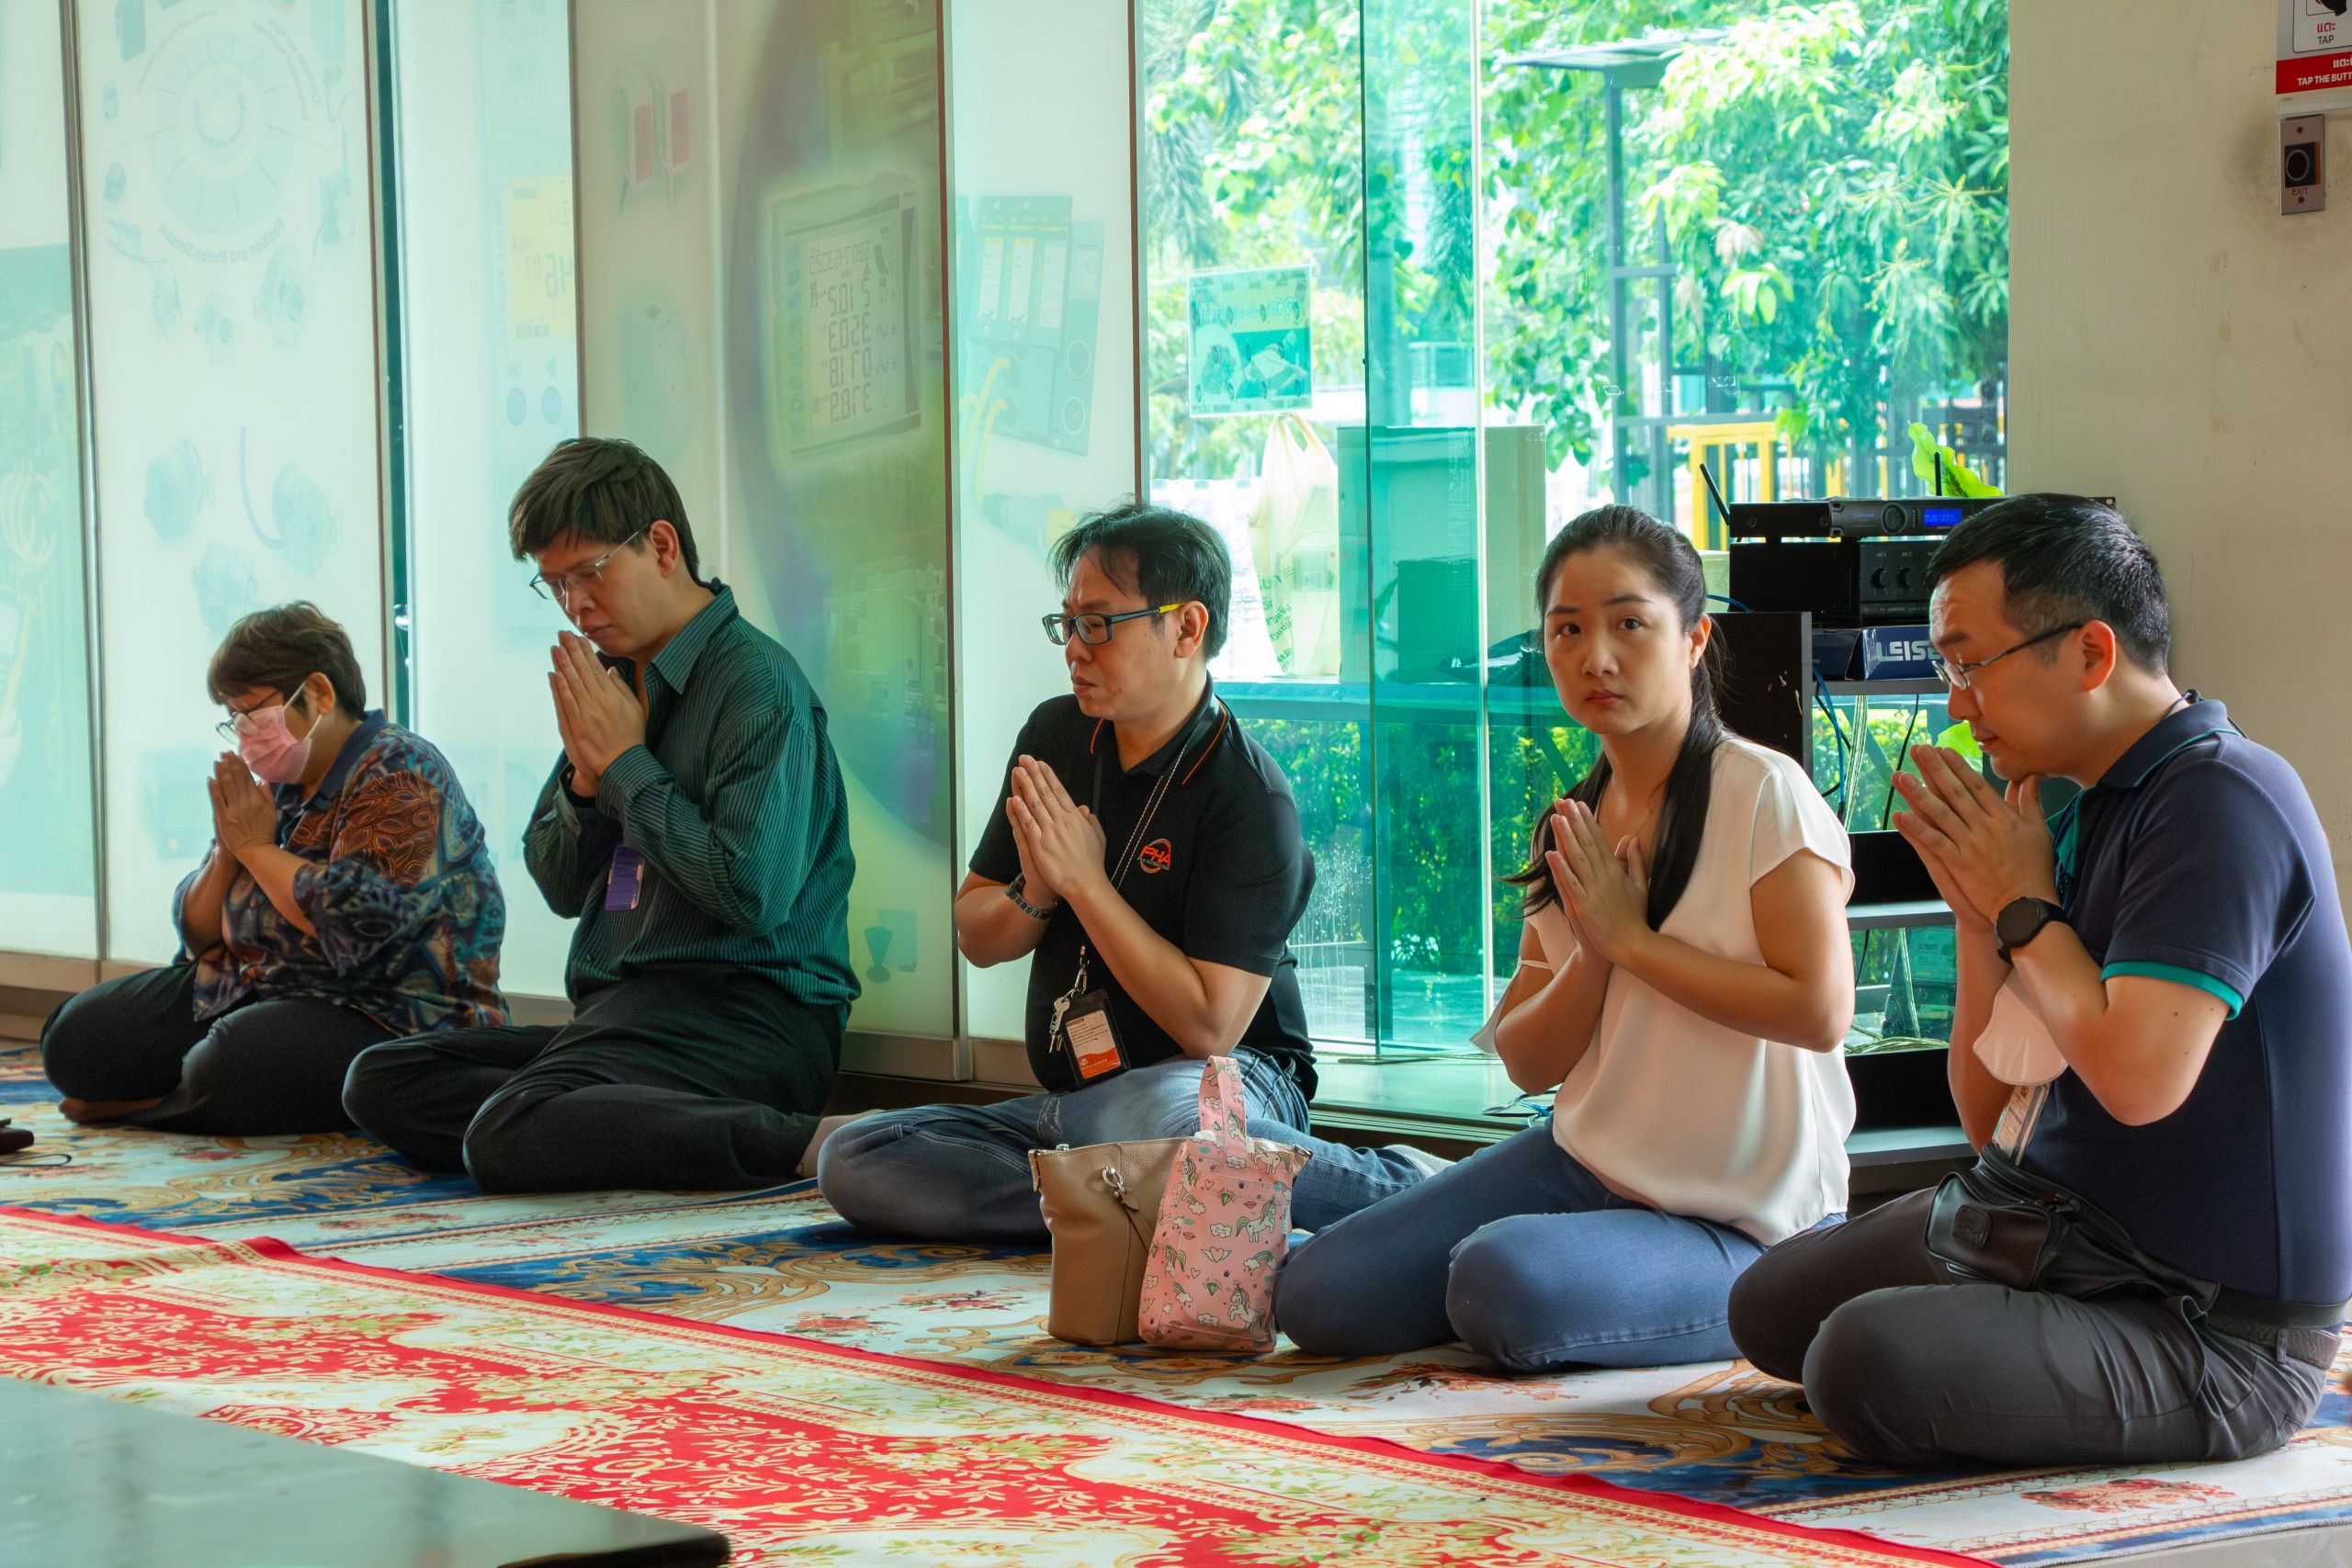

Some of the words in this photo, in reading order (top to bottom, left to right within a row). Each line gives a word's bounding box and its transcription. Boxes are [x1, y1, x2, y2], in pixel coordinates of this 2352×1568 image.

[2318, 35, 2335, 44] TAP
[2298, 76, 2313, 86] TAP
[2314, 73, 2331, 84] THE
[2291, 187, 2308, 196] EXIT
